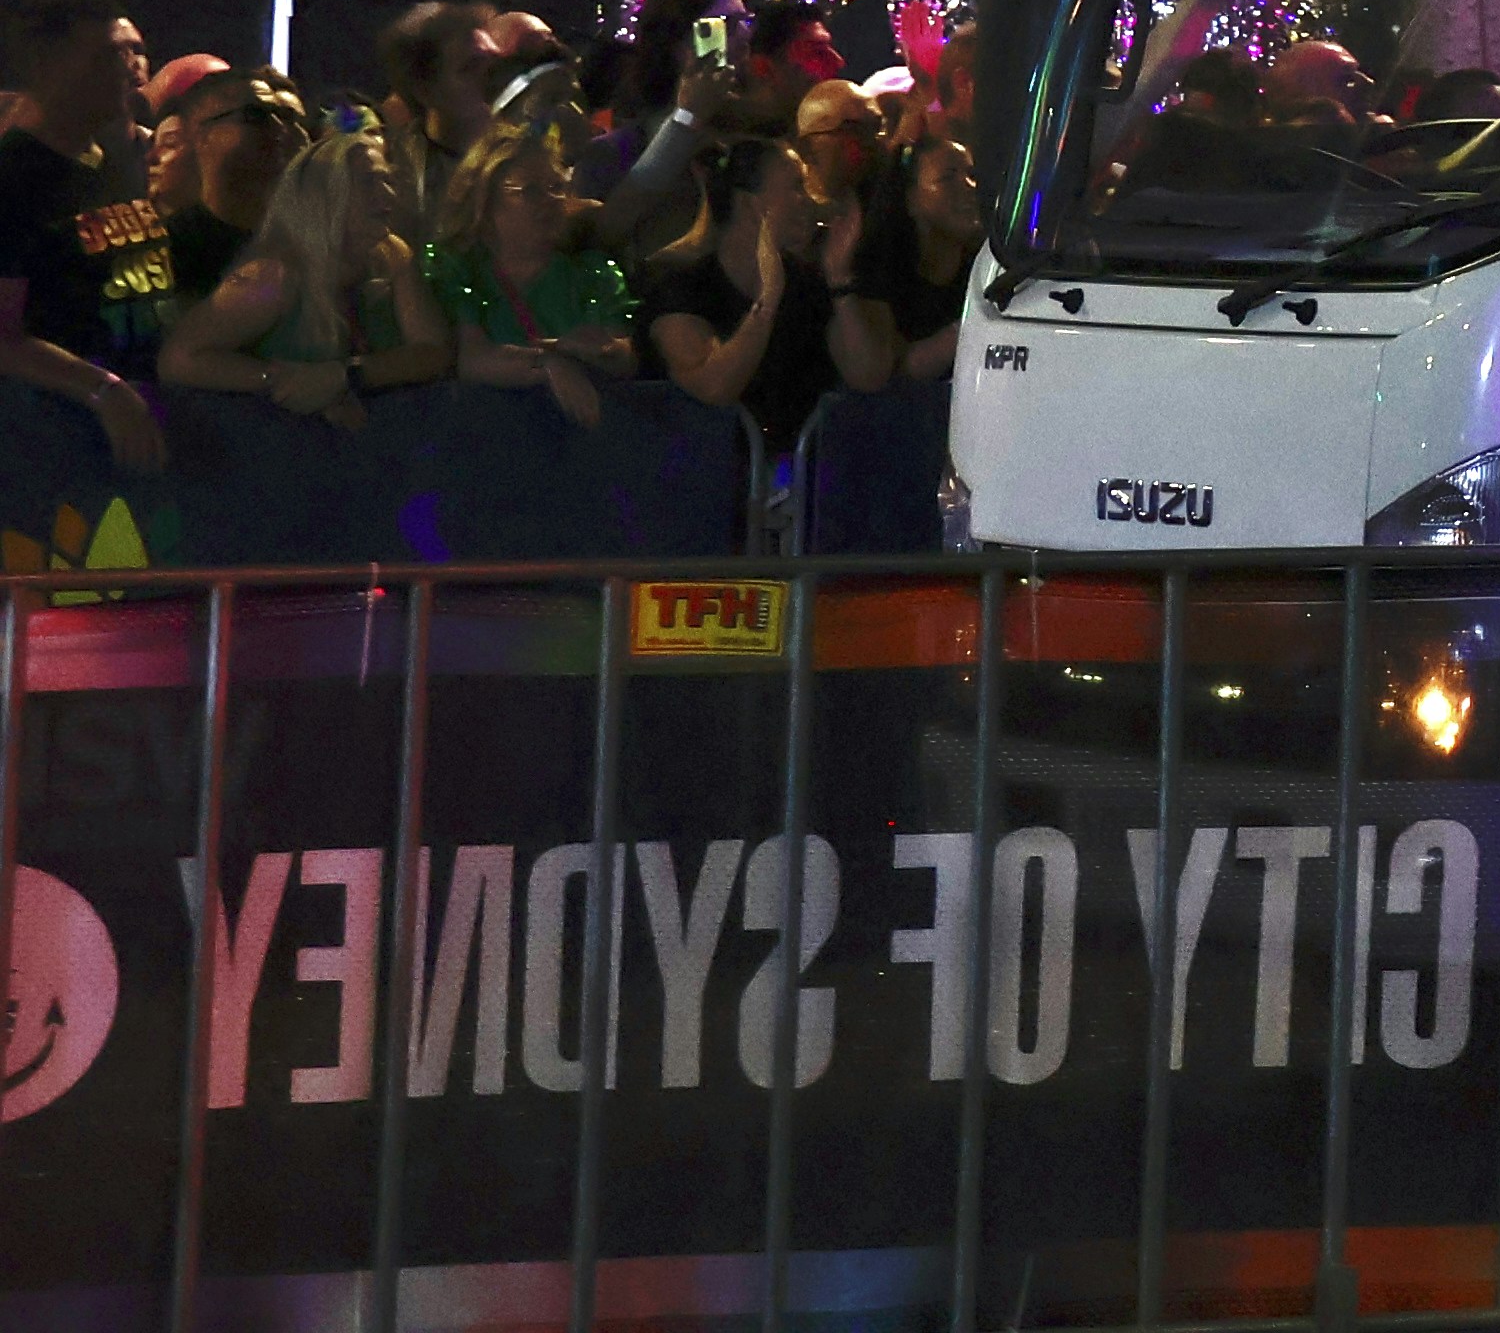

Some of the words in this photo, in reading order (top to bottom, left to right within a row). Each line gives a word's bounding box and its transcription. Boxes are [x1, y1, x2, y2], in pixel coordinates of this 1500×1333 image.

[984, 344, 1029, 372] NPR
[1096, 477, 1214, 528] ISUZU
[650, 584, 758, 630] TFH
